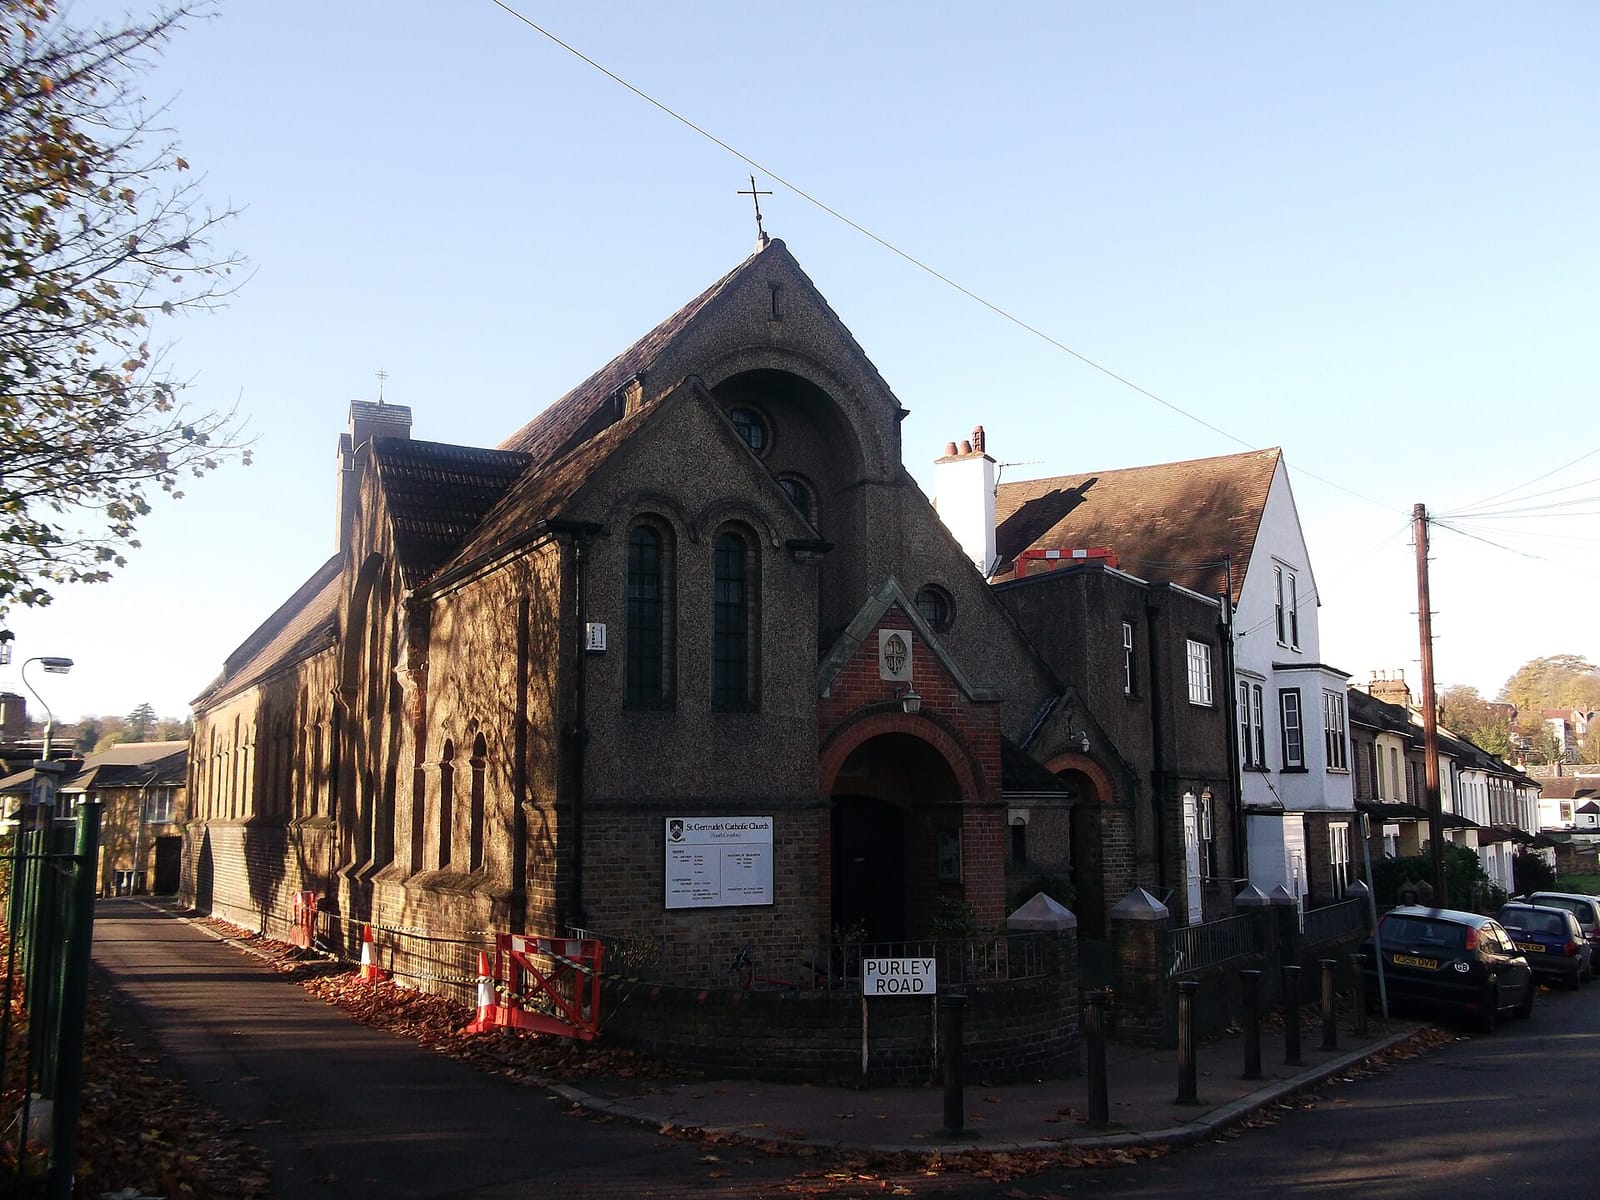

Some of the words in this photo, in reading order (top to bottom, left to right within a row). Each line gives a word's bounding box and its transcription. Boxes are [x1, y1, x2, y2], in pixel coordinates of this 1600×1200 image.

[694, 823, 723, 831] Gertrude's
[725, 822, 748, 830] Catholic
[748, 822, 769, 830] Church
[867, 960, 932, 975] PURLEY
[1457, 963, 1468, 971] GB
[876, 978, 924, 993] ROAD
